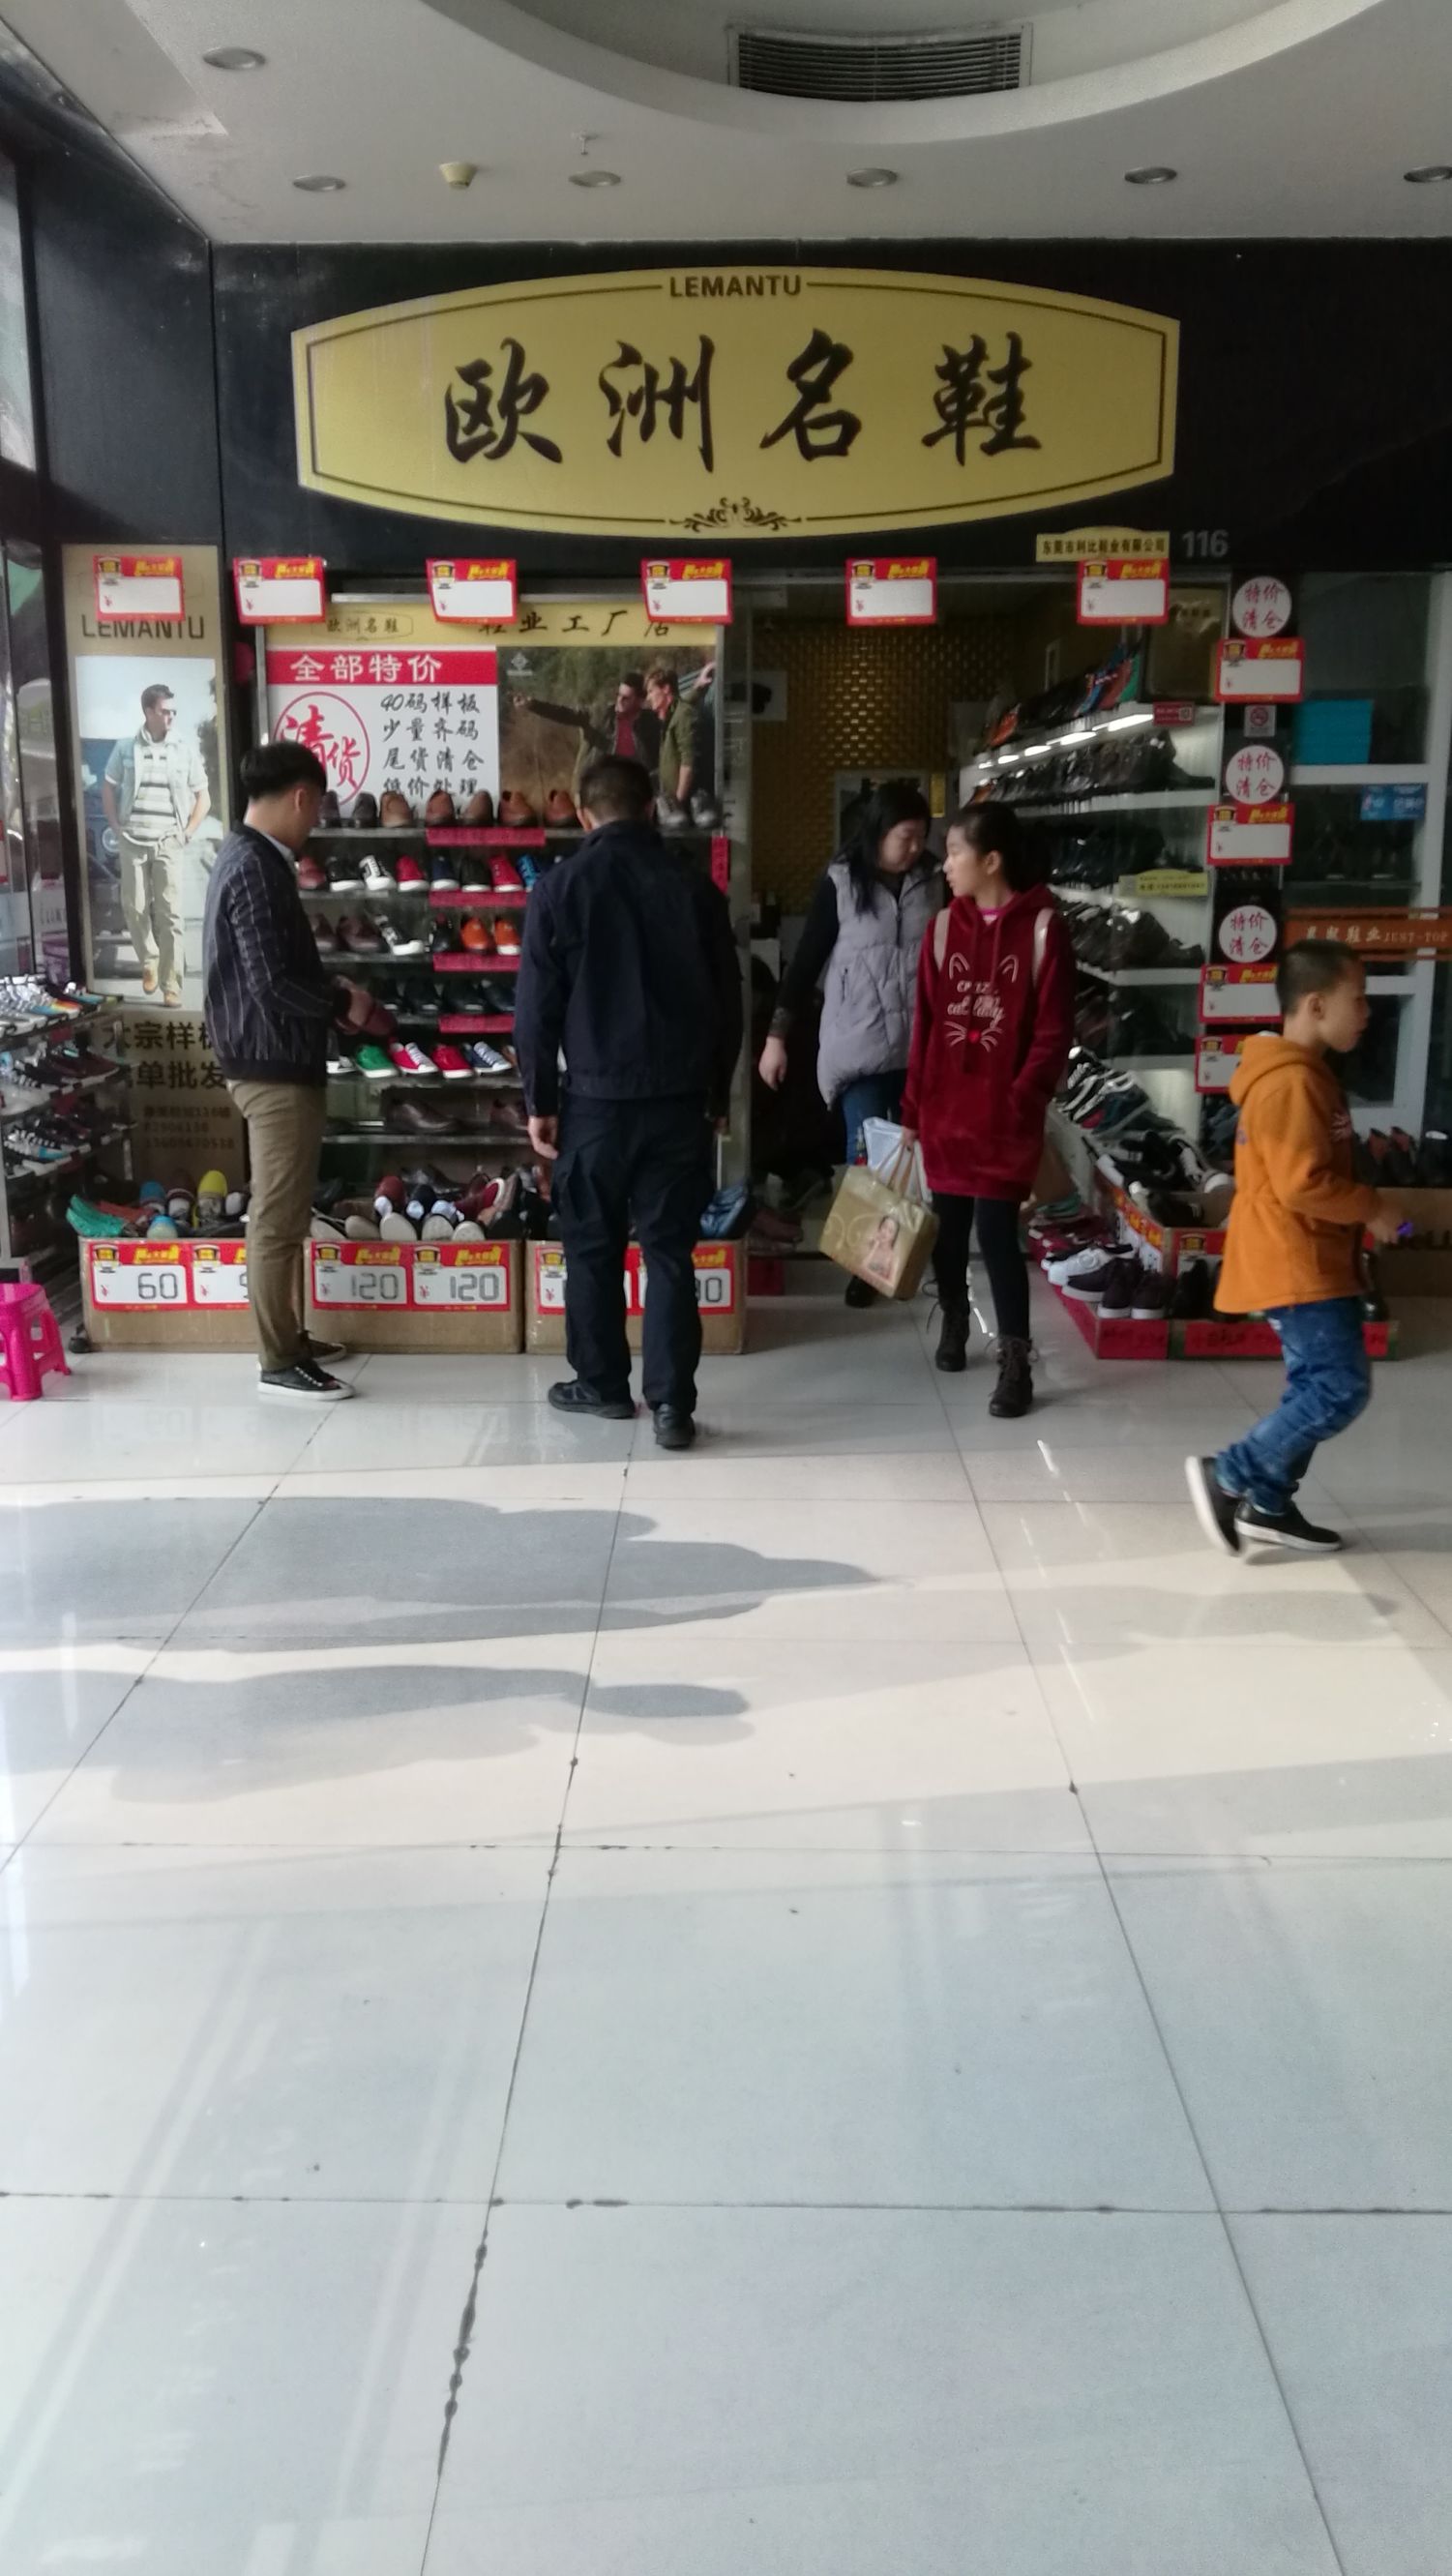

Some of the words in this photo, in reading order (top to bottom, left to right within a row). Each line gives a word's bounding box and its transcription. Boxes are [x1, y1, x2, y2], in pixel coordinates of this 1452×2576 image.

[670, 275, 801, 299] LEMANTU
[444, 328, 1042, 474] 欧洲名鞋
[1182, 530, 1229, 557] 116
[1243, 582, 1284, 604] 特价
[325, 616, 399, 634] 欧洲名鞋
[1242, 608, 1284, 631] 清仓
[290, 653, 443, 683] 全部特价
[380, 691, 481, 715] 40码样板
[383, 747, 485, 772] 尾货清仓
[1237, 751, 1277, 771] 特价
[1236, 776, 1276, 798] 清仓
[1230, 912, 1268, 932] 特价
[1230, 935, 1268, 957] 清仓
[137, 1272, 178, 1300] 60
[350, 1272, 400, 1301] 120
[449, 1272, 500, 1302] 120
